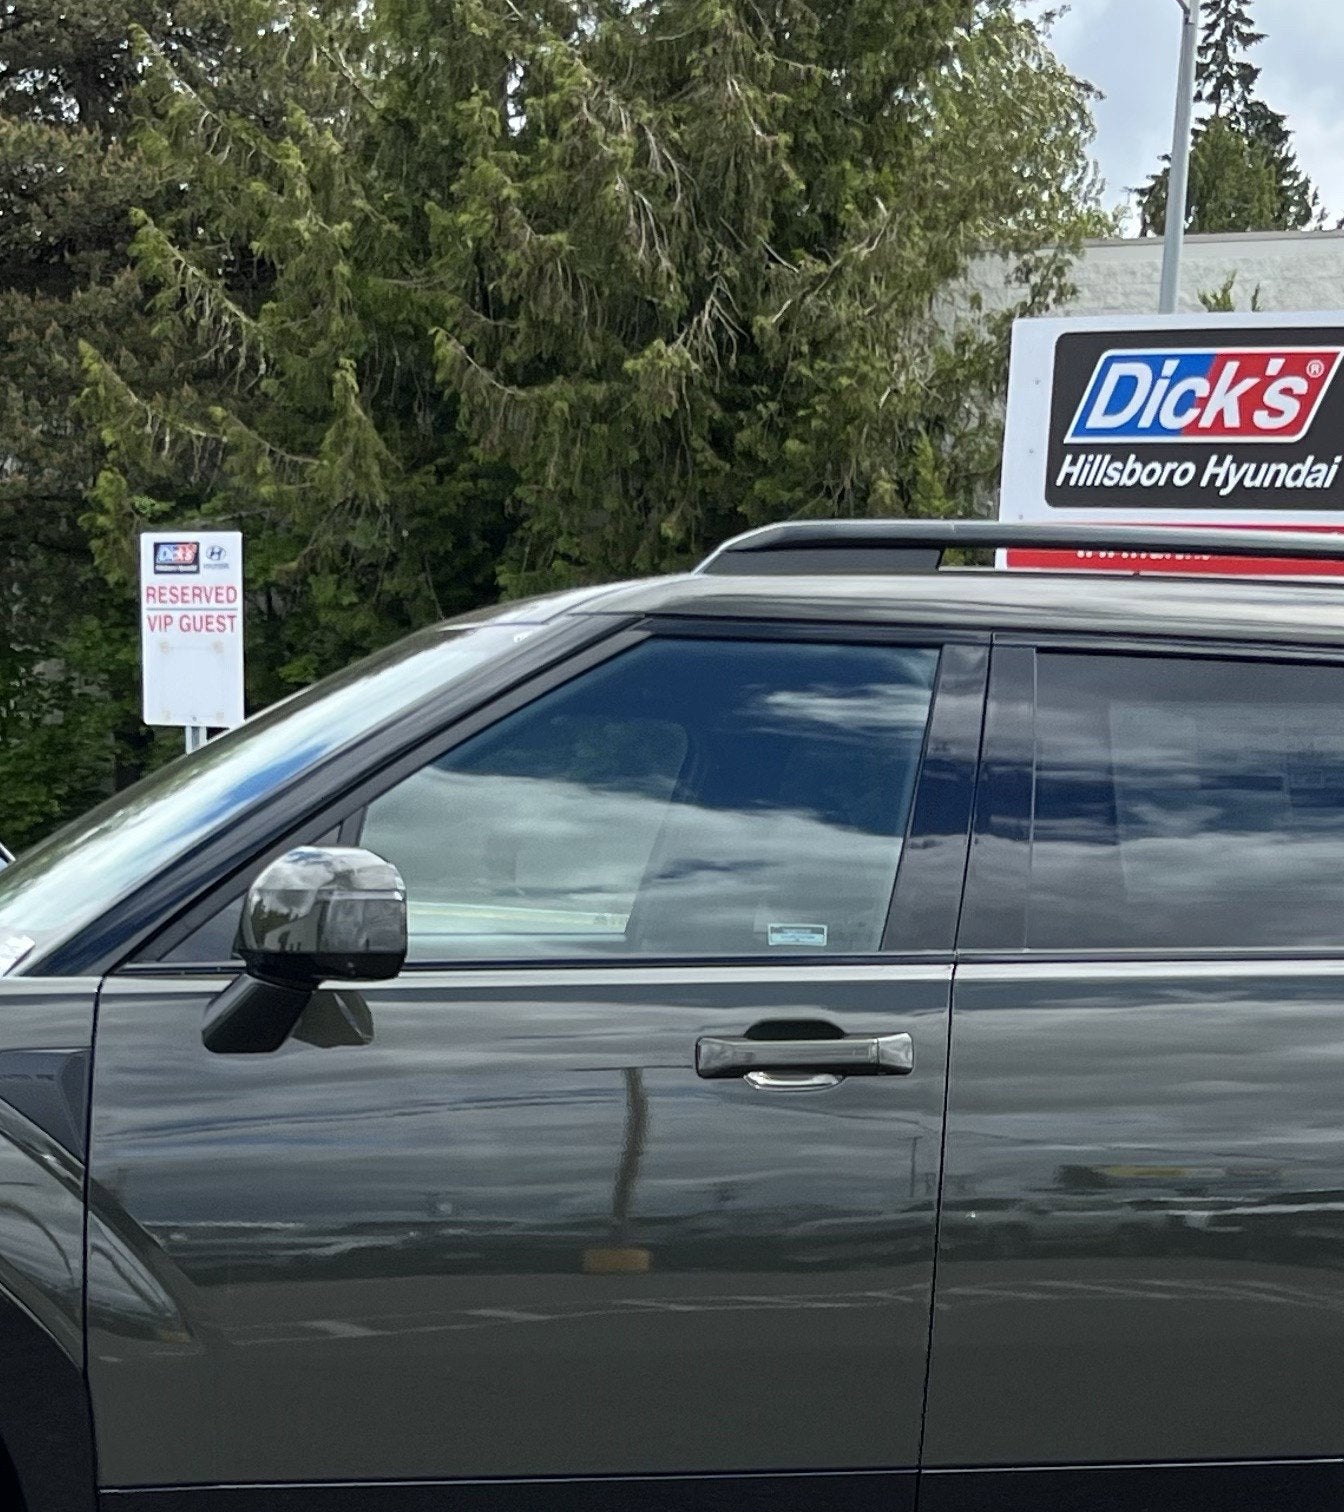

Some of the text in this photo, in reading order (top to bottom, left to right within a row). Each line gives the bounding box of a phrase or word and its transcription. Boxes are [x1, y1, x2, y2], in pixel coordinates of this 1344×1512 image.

[1085, 358, 1309, 431] Dick's
[1055, 453, 1344, 497] Hillsboro Hyundai
[146, 585, 238, 604] RESERVED
[147, 614, 238, 633] VIP GUEST
